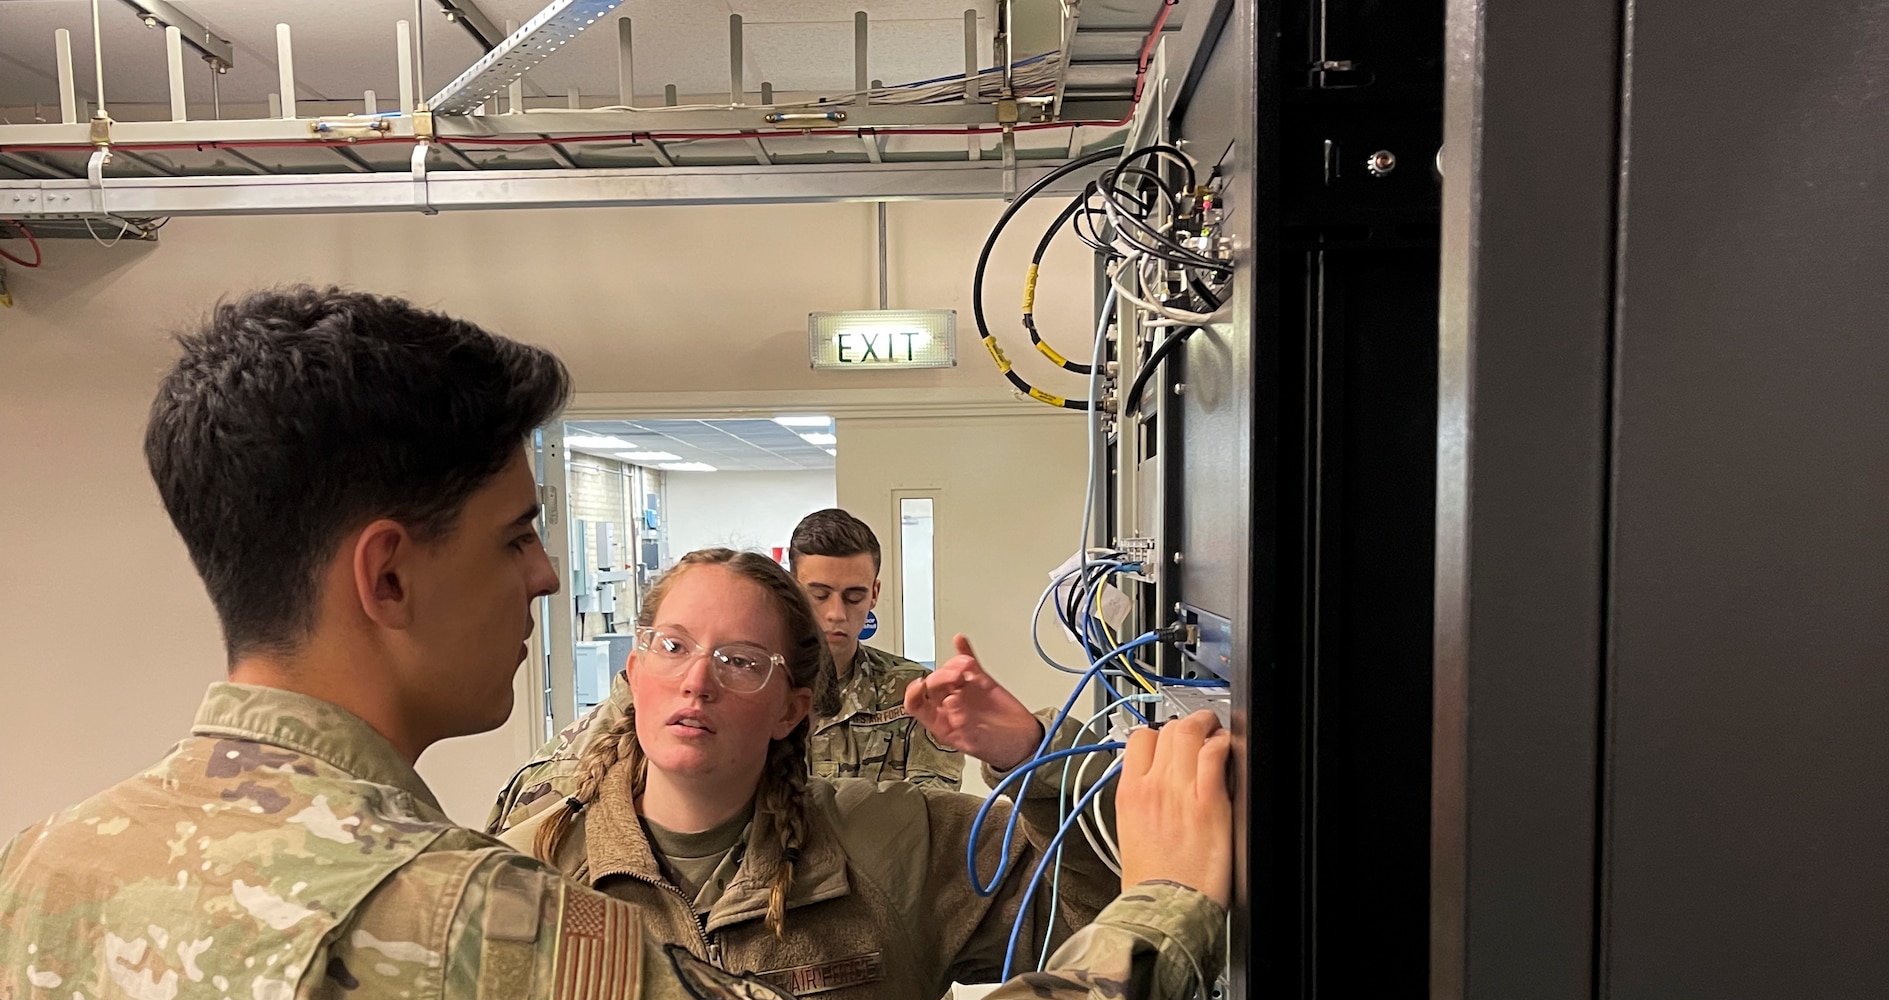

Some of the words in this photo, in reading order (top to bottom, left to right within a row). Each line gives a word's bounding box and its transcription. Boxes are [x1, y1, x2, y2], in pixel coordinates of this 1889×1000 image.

[838, 333, 919, 363] EXIT
[869, 712, 883, 723] AIR
[884, 706, 908, 721] FORC
[791, 967, 817, 993] AIR
[822, 958, 876, 988] FORCE
